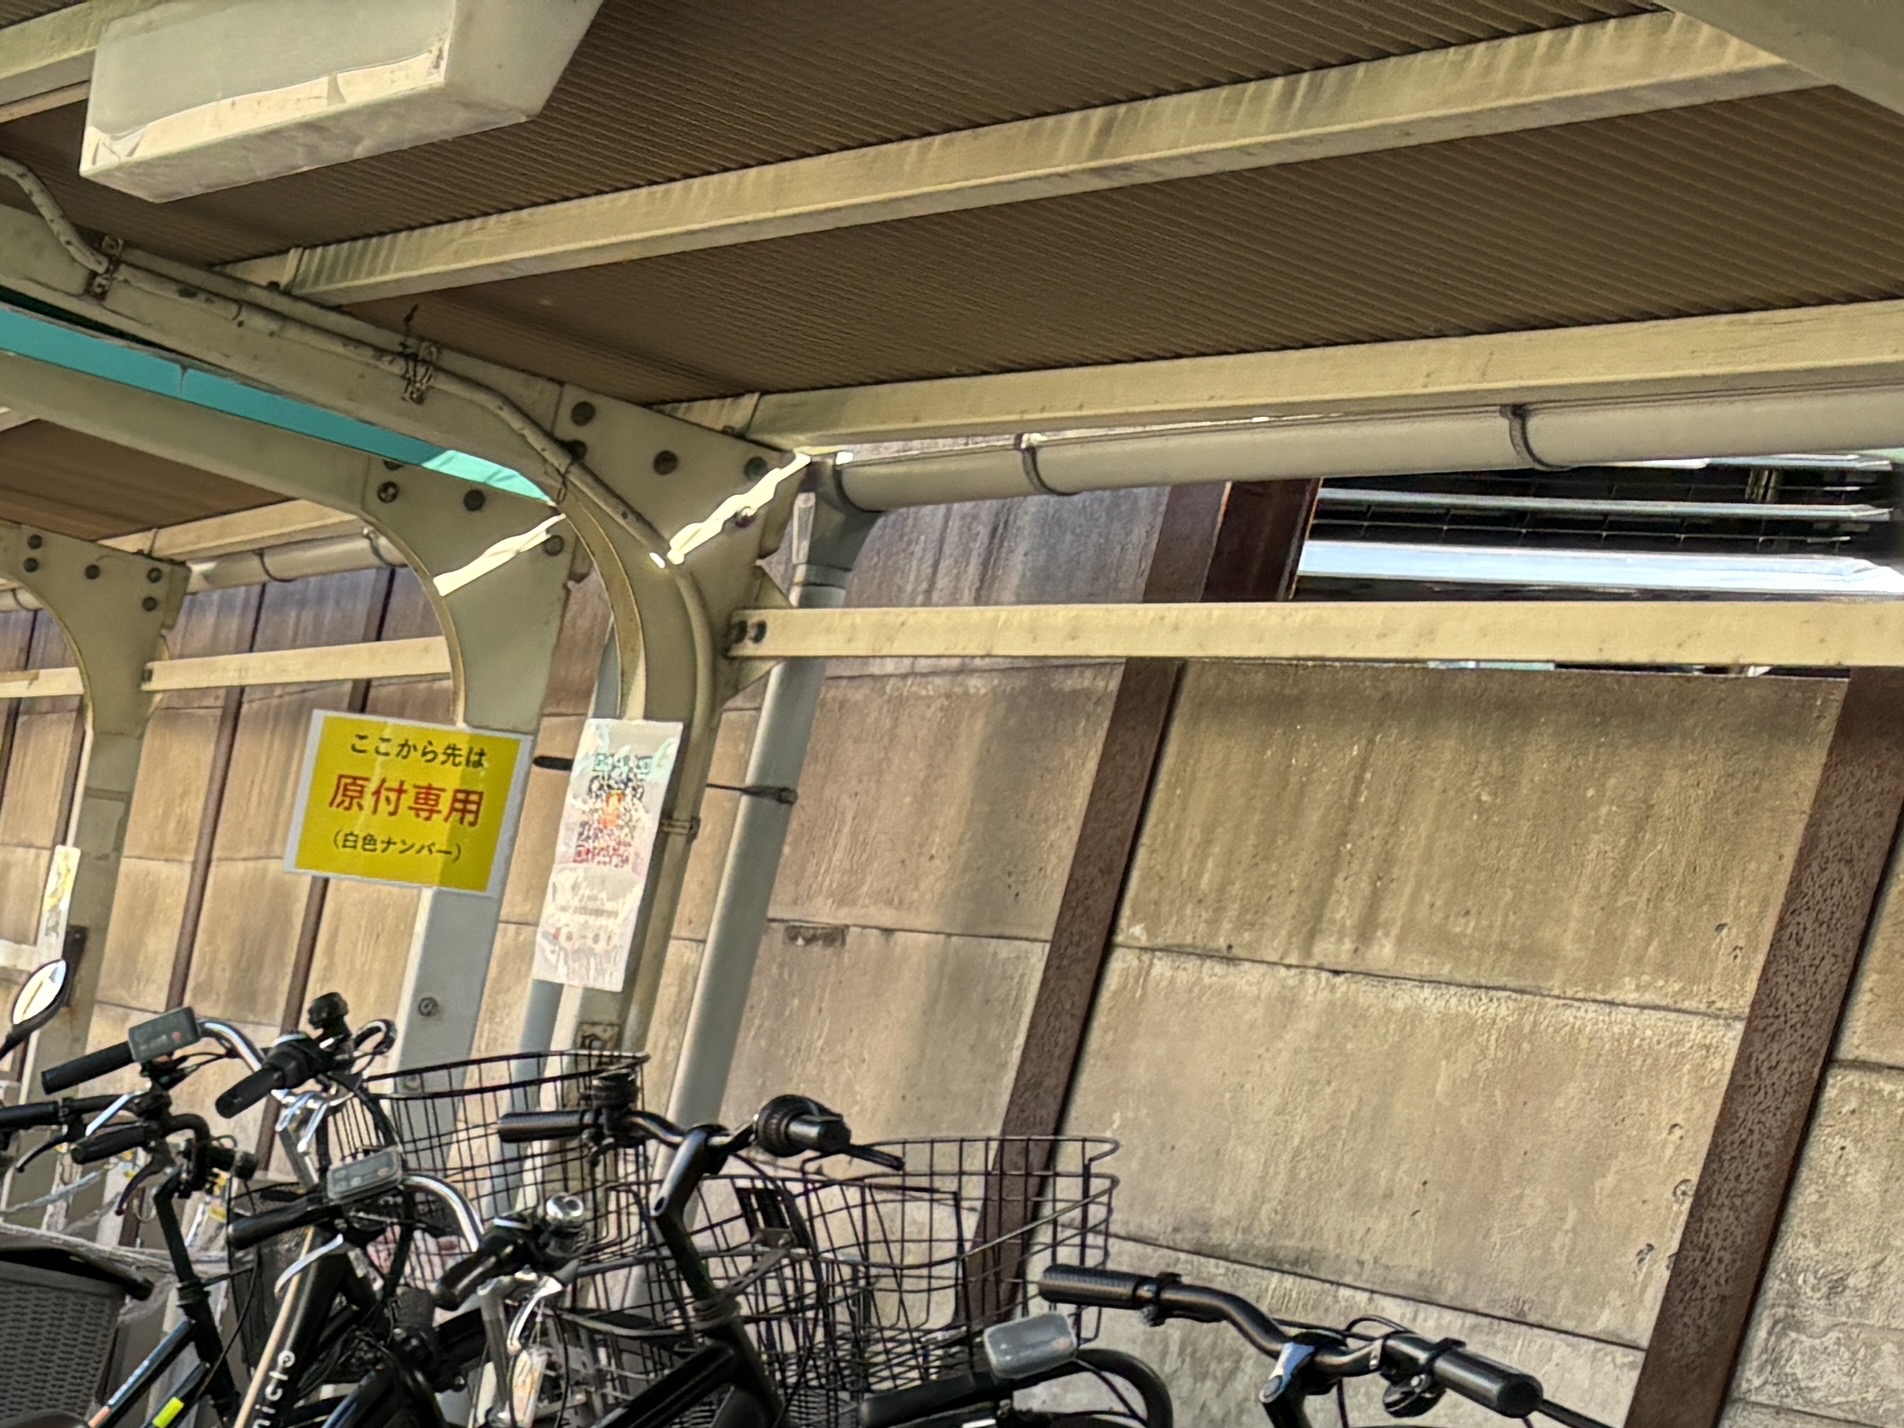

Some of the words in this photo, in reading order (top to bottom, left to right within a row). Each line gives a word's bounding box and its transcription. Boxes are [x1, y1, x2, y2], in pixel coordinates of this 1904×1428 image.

[350, 733, 488, 768] ここから先は
[328, 773, 485, 828] 原付専用
